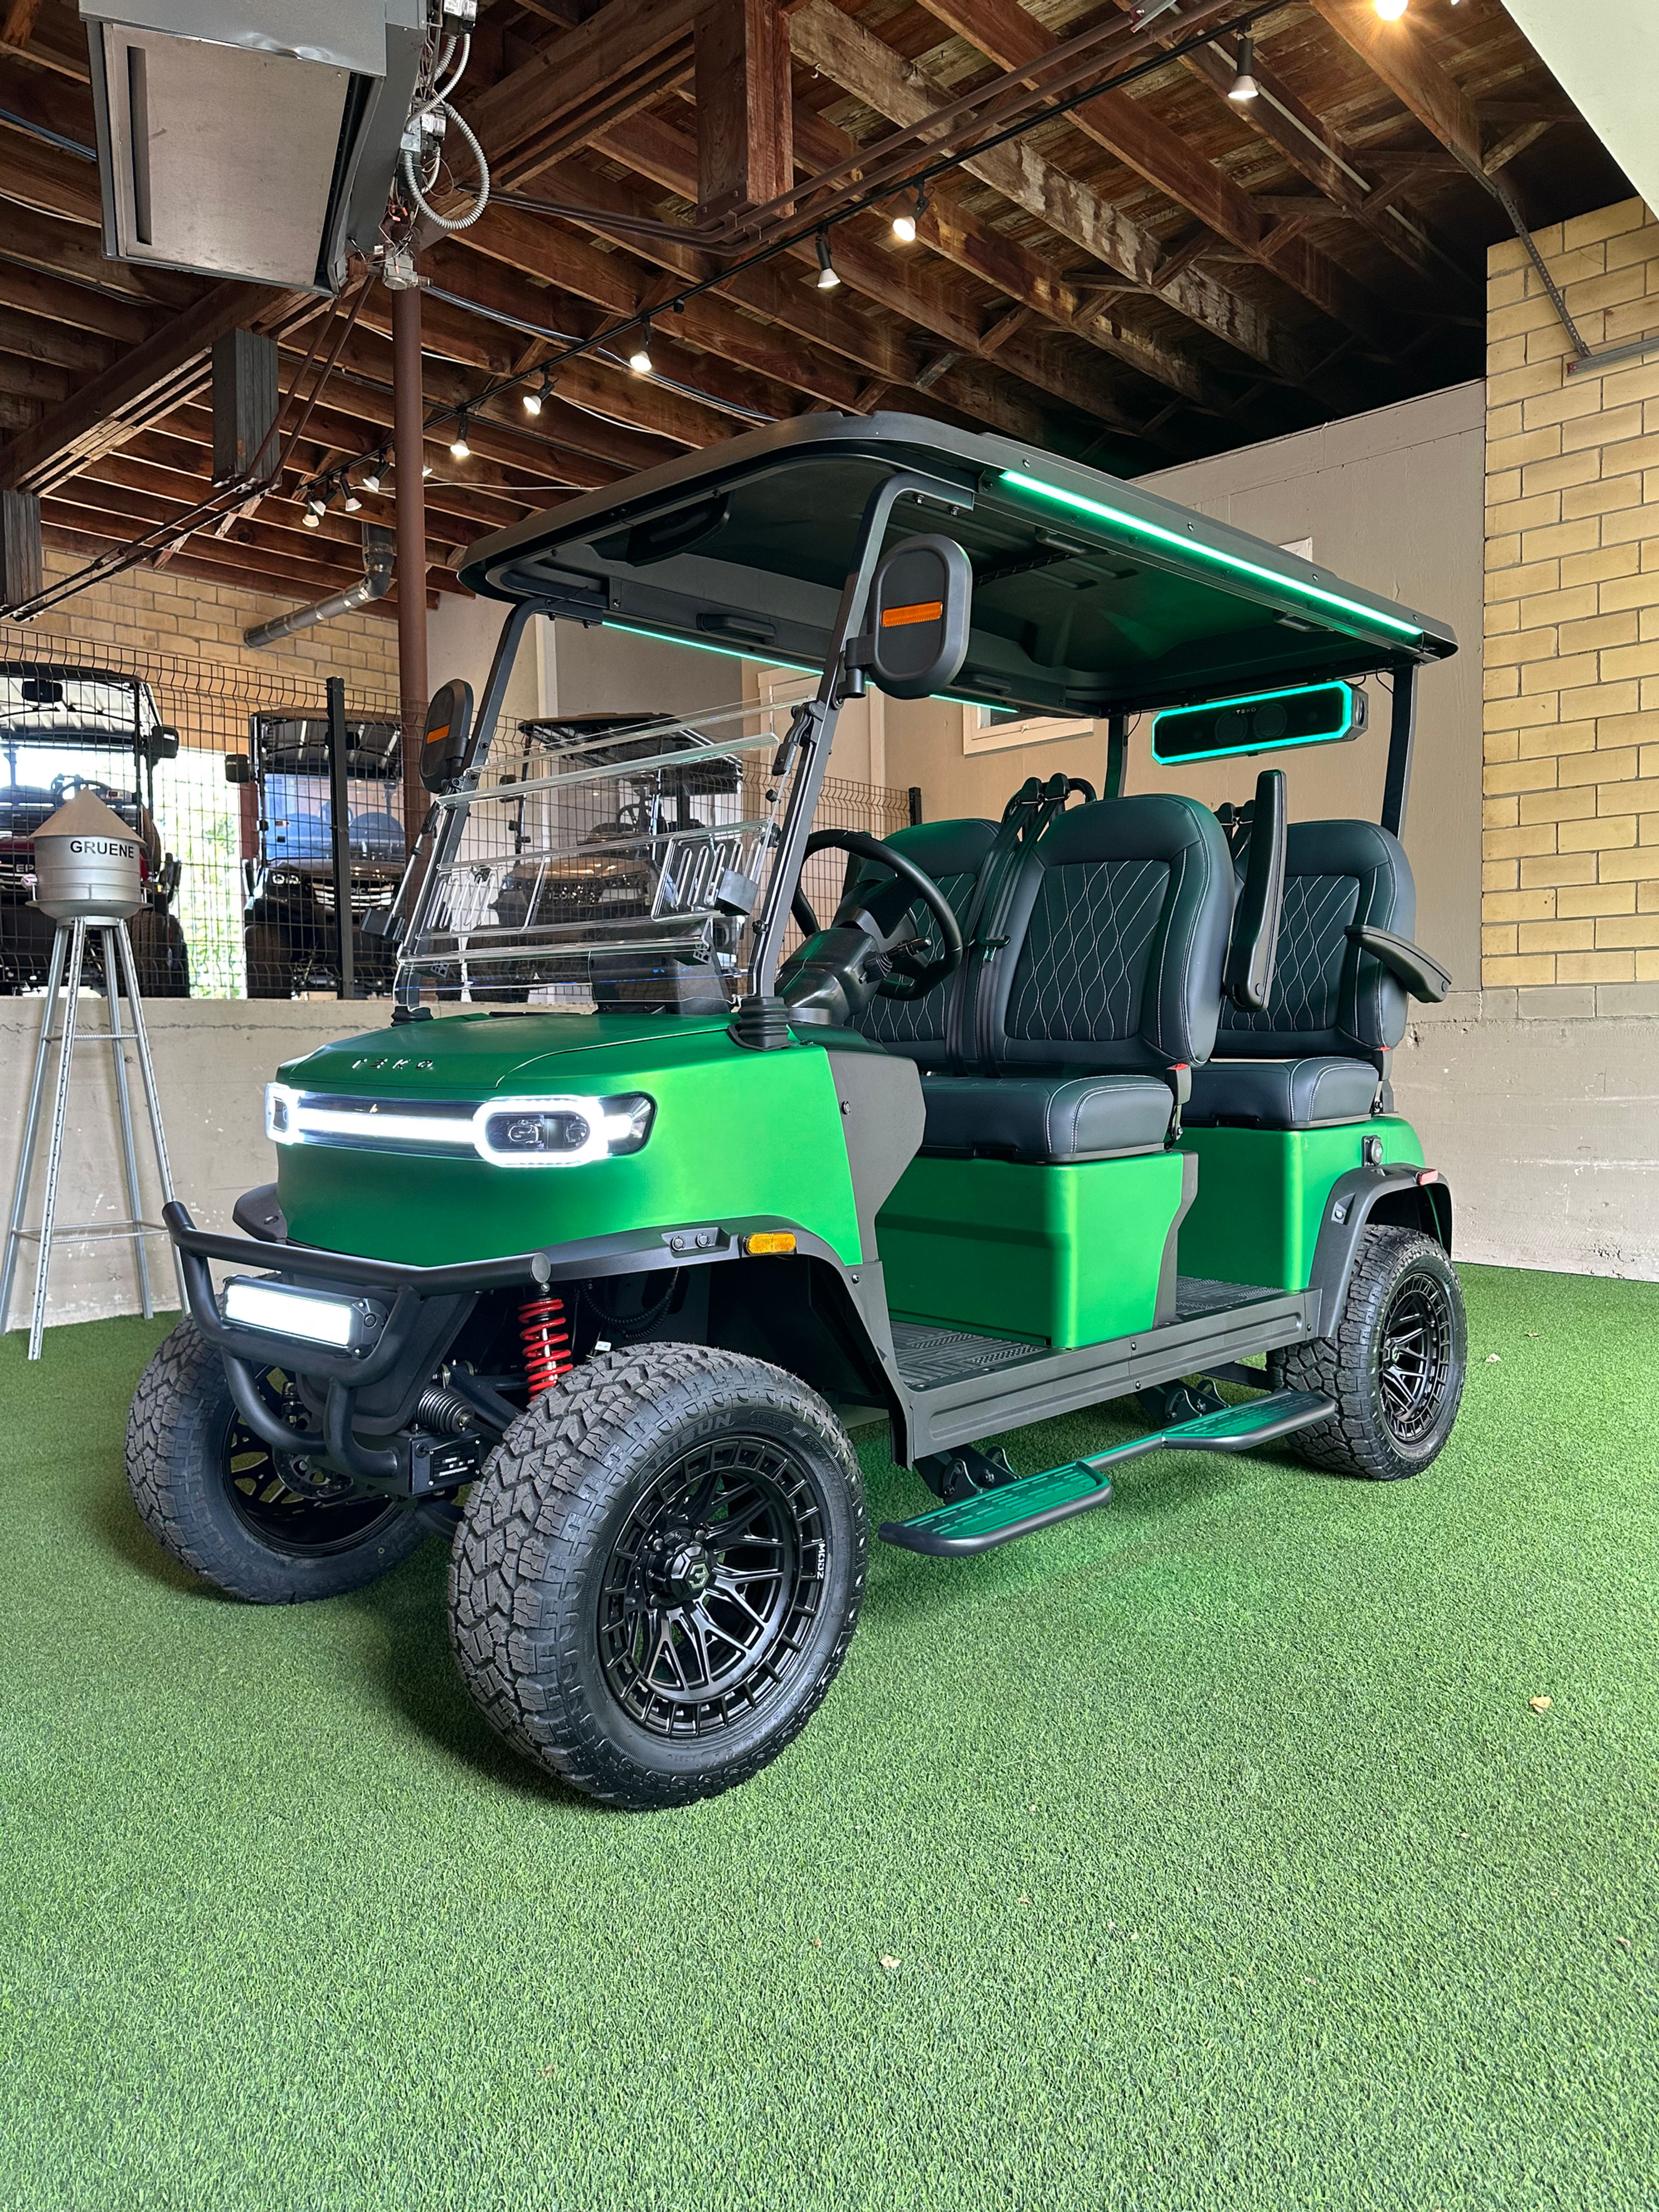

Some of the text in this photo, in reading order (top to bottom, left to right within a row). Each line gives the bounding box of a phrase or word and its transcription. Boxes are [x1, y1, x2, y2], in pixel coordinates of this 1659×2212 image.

[70, 840, 134, 859] GRUENE
[15, 864, 35, 872] EP
[351, 887, 366, 895] PIC
[816, 1543, 826, 1580] MODZ
